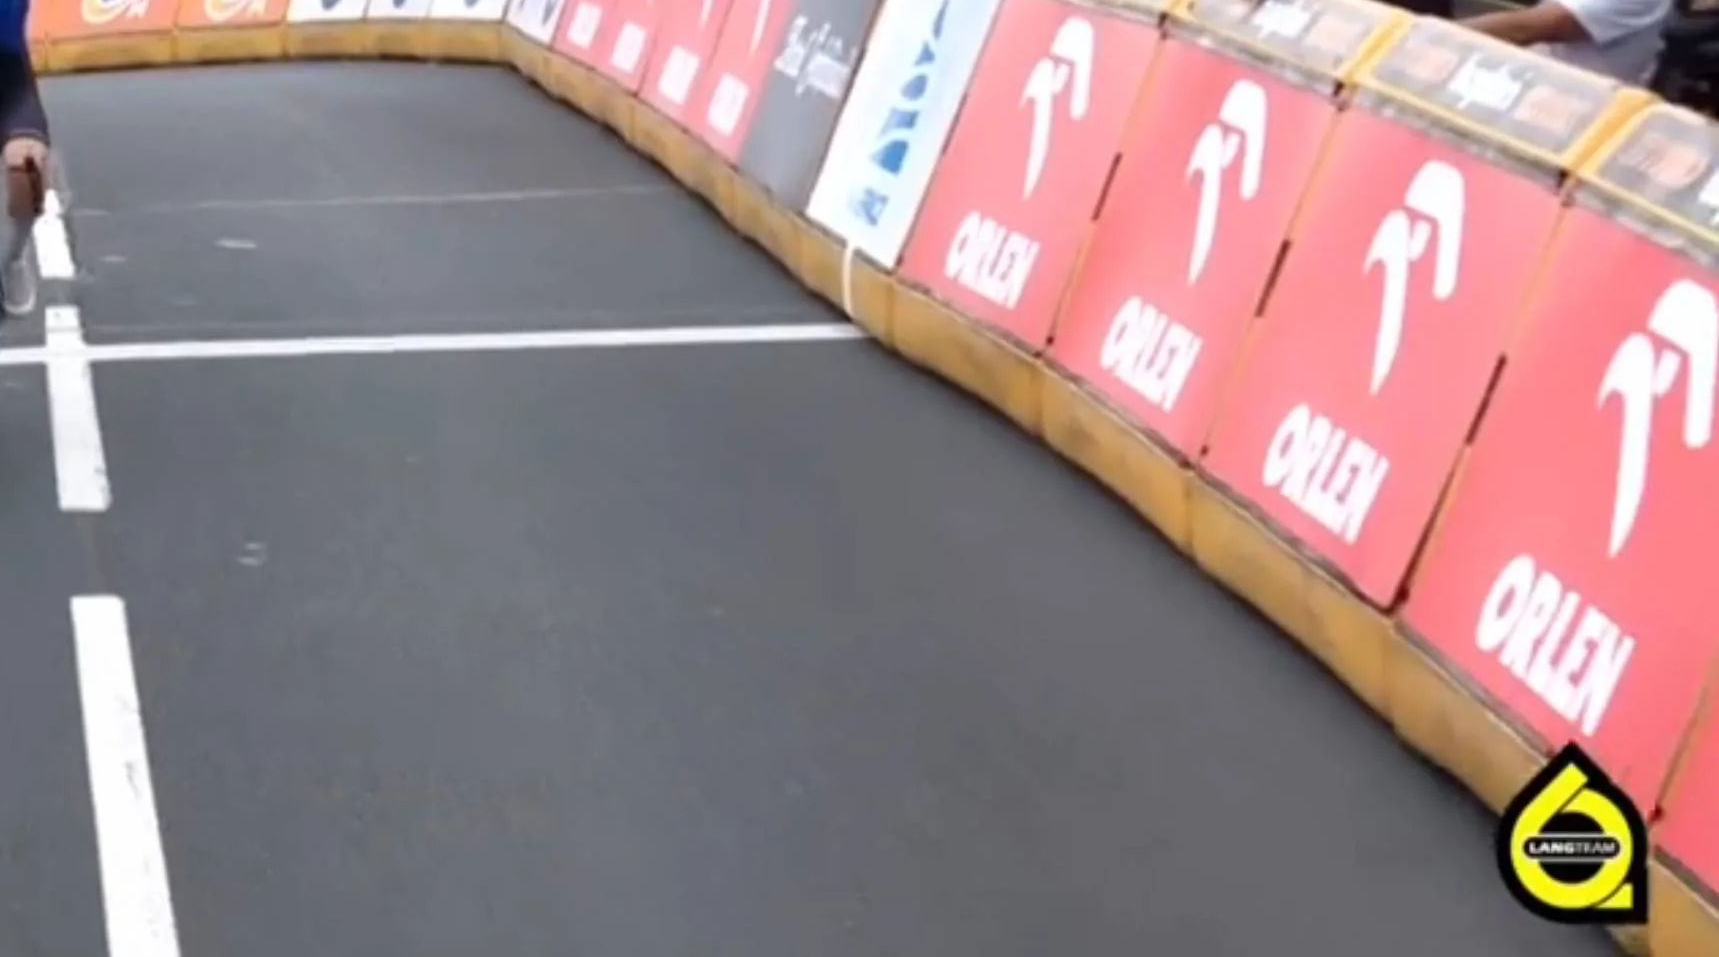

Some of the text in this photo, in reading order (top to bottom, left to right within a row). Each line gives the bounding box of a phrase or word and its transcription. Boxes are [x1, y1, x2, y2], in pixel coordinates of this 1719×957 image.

[944, 210, 1042, 311] ORLEN
[1100, 294, 1204, 413] ORLEN
[1262, 402, 1390, 546] ORLEN
[1475, 553, 1637, 739] ORLEN
